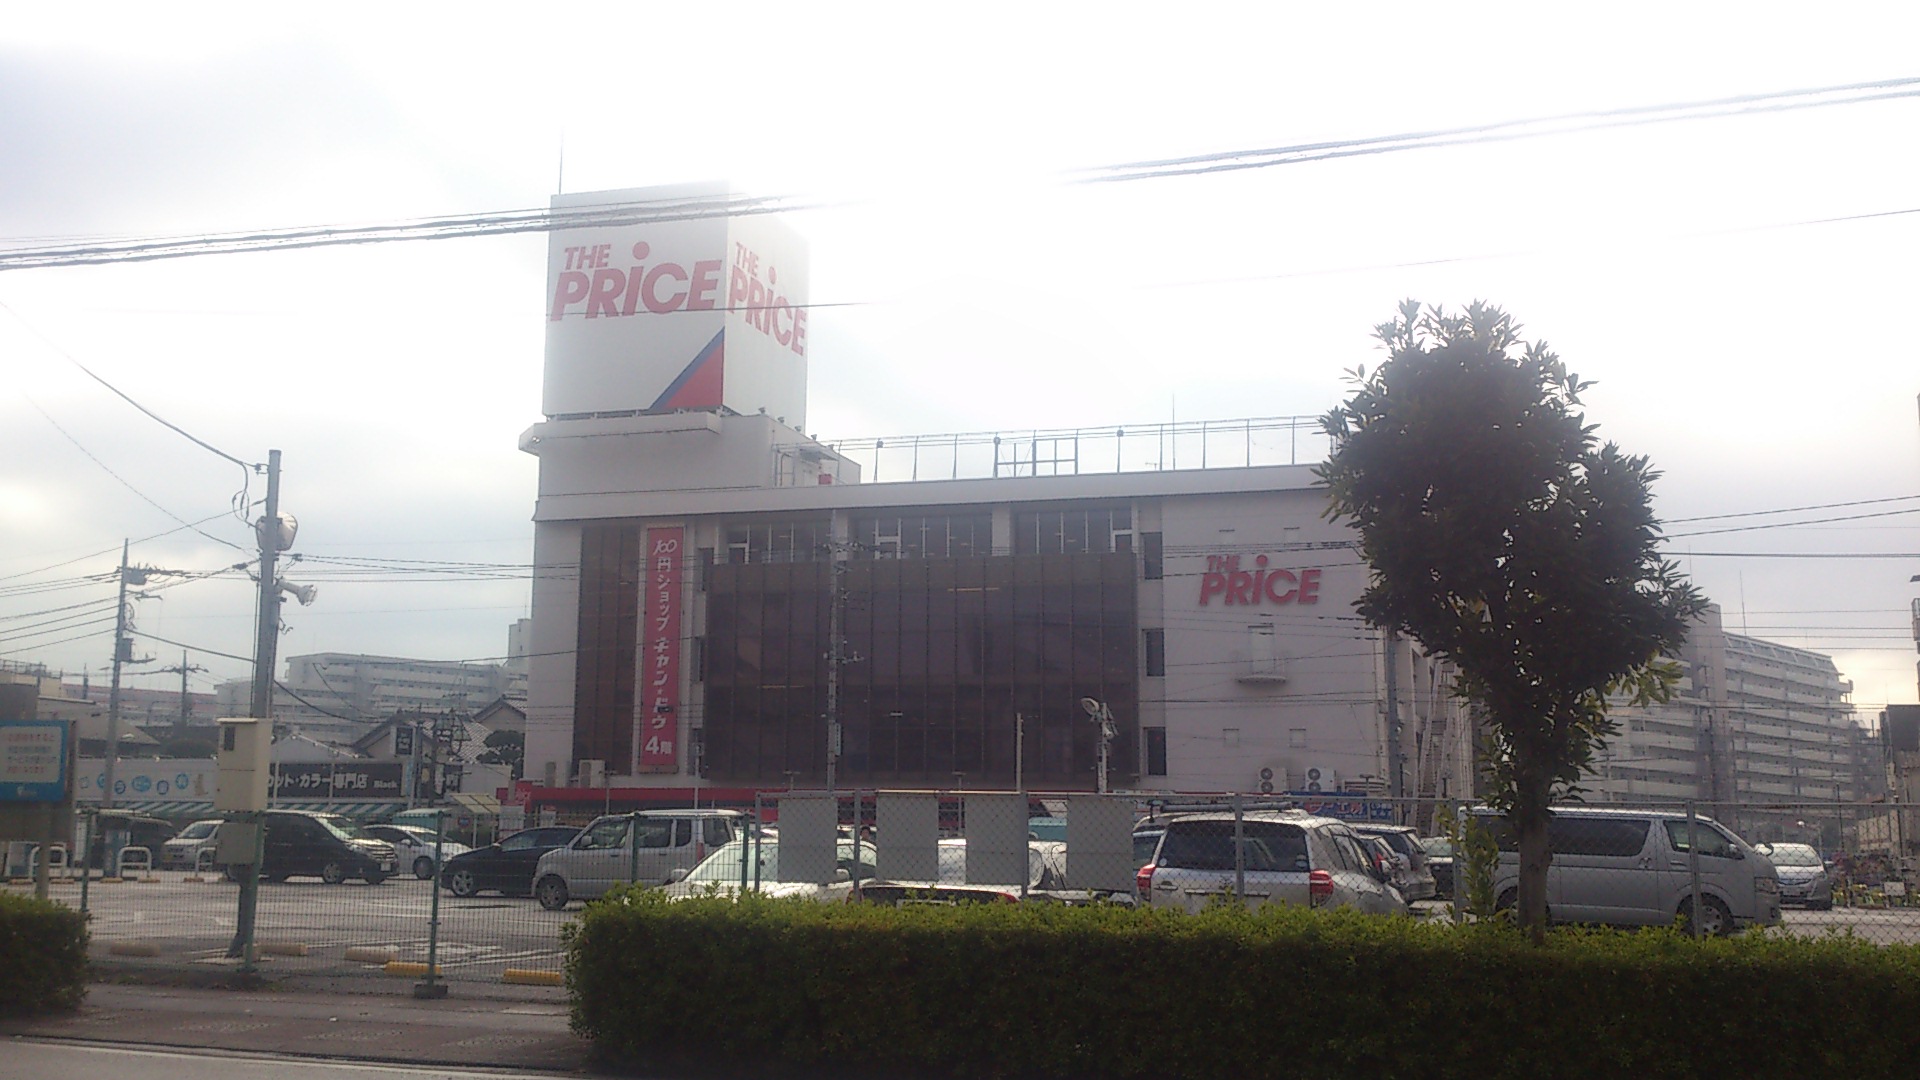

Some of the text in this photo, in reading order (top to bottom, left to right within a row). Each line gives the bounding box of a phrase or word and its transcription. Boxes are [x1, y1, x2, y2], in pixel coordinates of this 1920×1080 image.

[564, 244, 611, 270] THE
[735, 242, 759, 278] THE
[1207, 554, 1241, 572] THE
[645, 735, 673, 755] 4階
